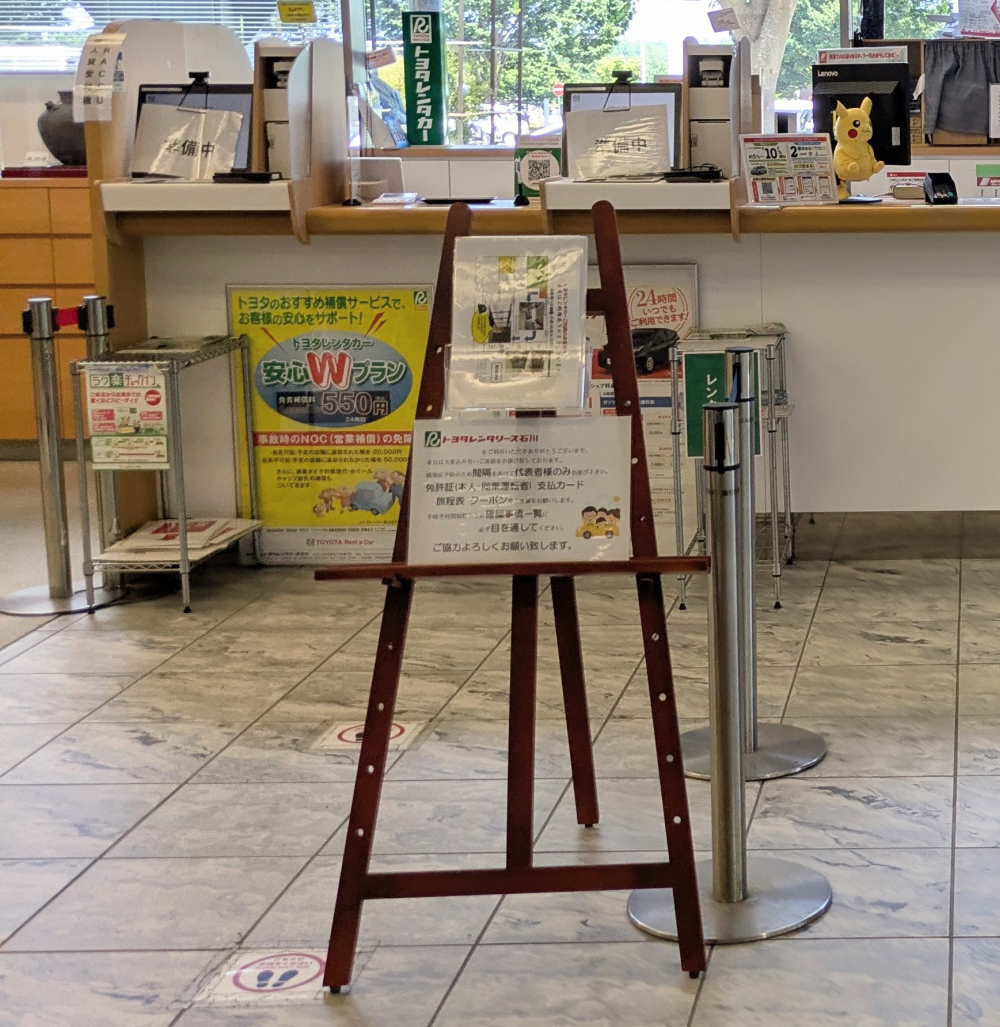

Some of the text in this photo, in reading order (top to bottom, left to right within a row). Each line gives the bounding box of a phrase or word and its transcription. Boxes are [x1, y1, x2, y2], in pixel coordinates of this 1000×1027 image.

[414, 45, 433, 142] トヨタレンタカー
[764, 147, 778, 160] 10
[238, 296, 407, 310] トヨタのおすすめ補償サービスで、
[635, 288, 678, 308] 24時間
[642, 304, 677, 316] いつでも
[630, 312, 690, 328] ご利用できます!
[292, 337, 375, 351] トヨタレンタカー
[261, 350, 407, 390] 安心Wプラン
[706, 373, 718, 403] レン
[321, 391, 390, 416] 550円
[442, 434, 539, 444] トヨタレンタリース石川
[537, 480, 585, 490] 支払カード
